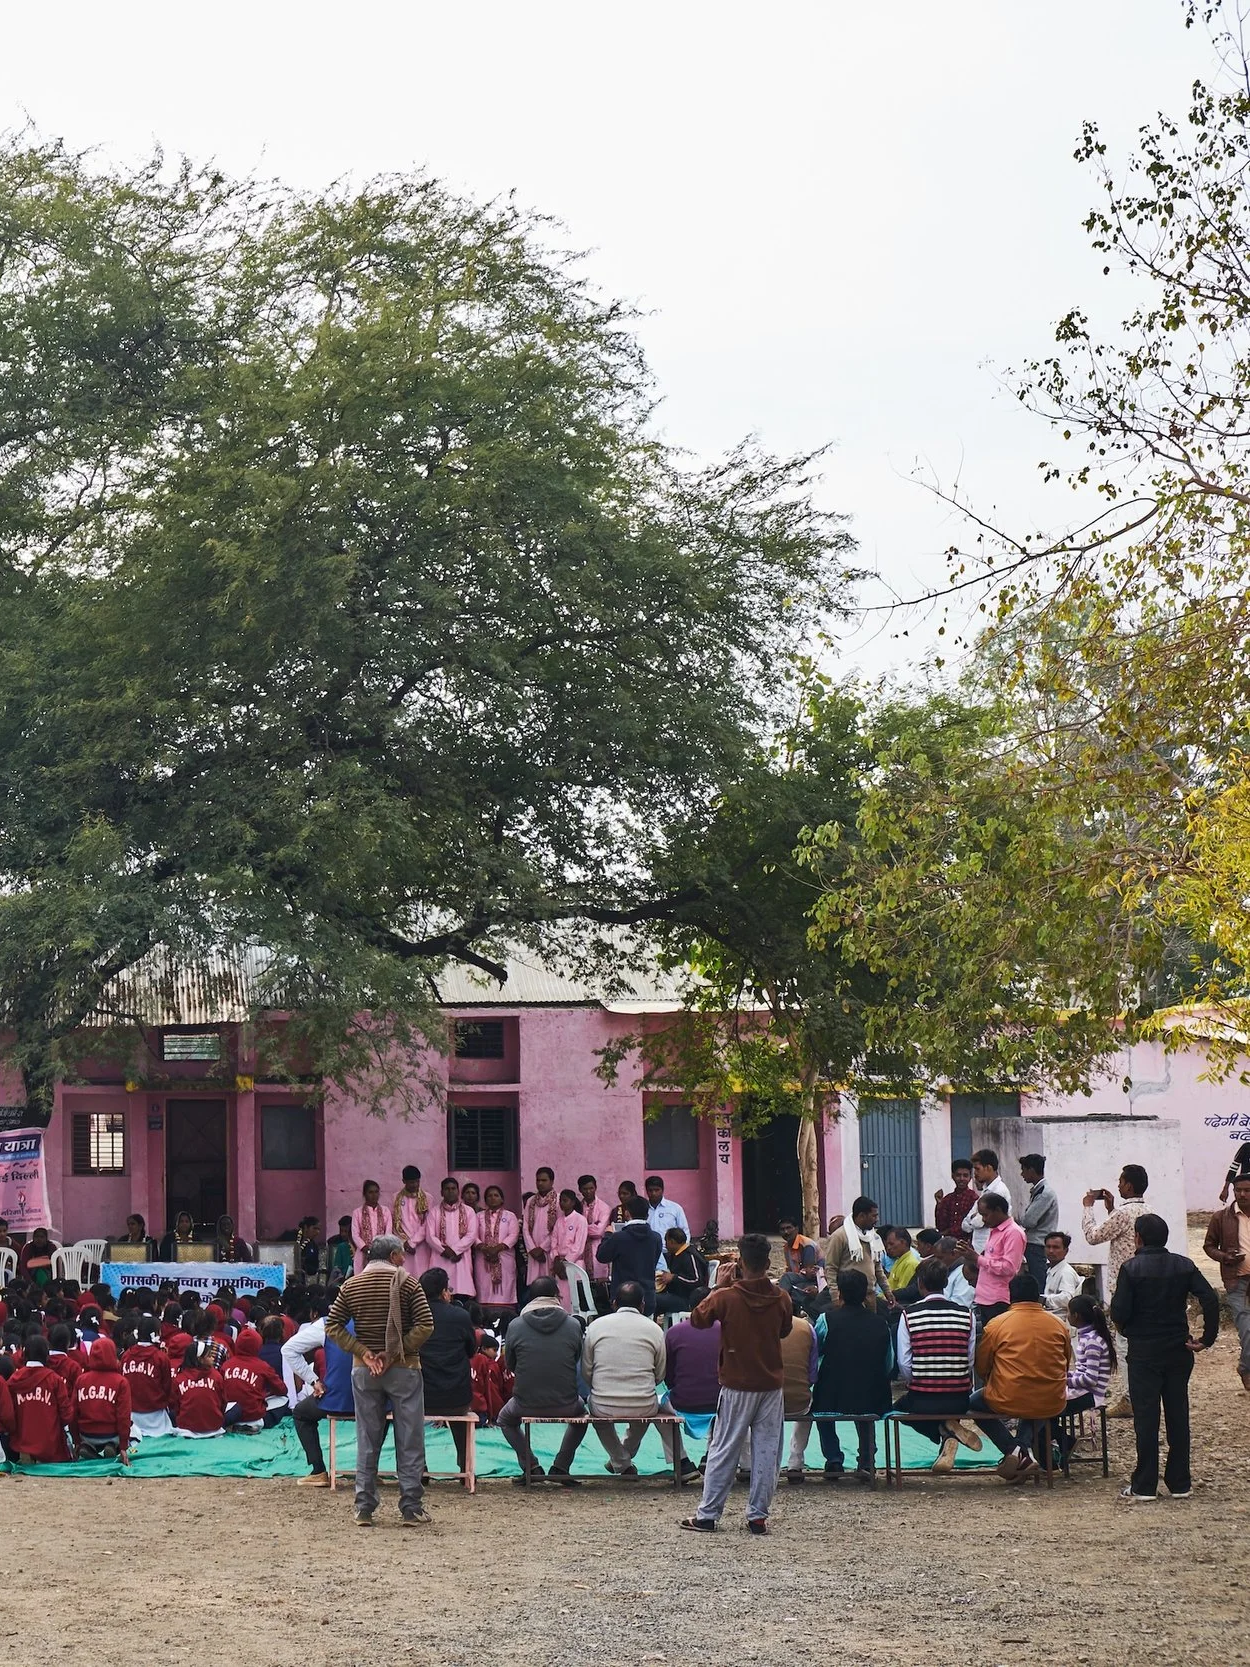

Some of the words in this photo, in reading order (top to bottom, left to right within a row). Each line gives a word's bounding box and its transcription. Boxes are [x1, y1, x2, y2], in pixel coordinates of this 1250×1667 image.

[1239, 1113, 1250, 1127] बे
[4, 1138, 37, 1152] यात्रा
[11, 1169, 39, 1182] दिल्ली
[173, 1275, 209, 1288] च्चतर
[211, 1276, 265, 1290] माध्यमिक
[77, 1386, 116, 1403] K.G.B.V.
